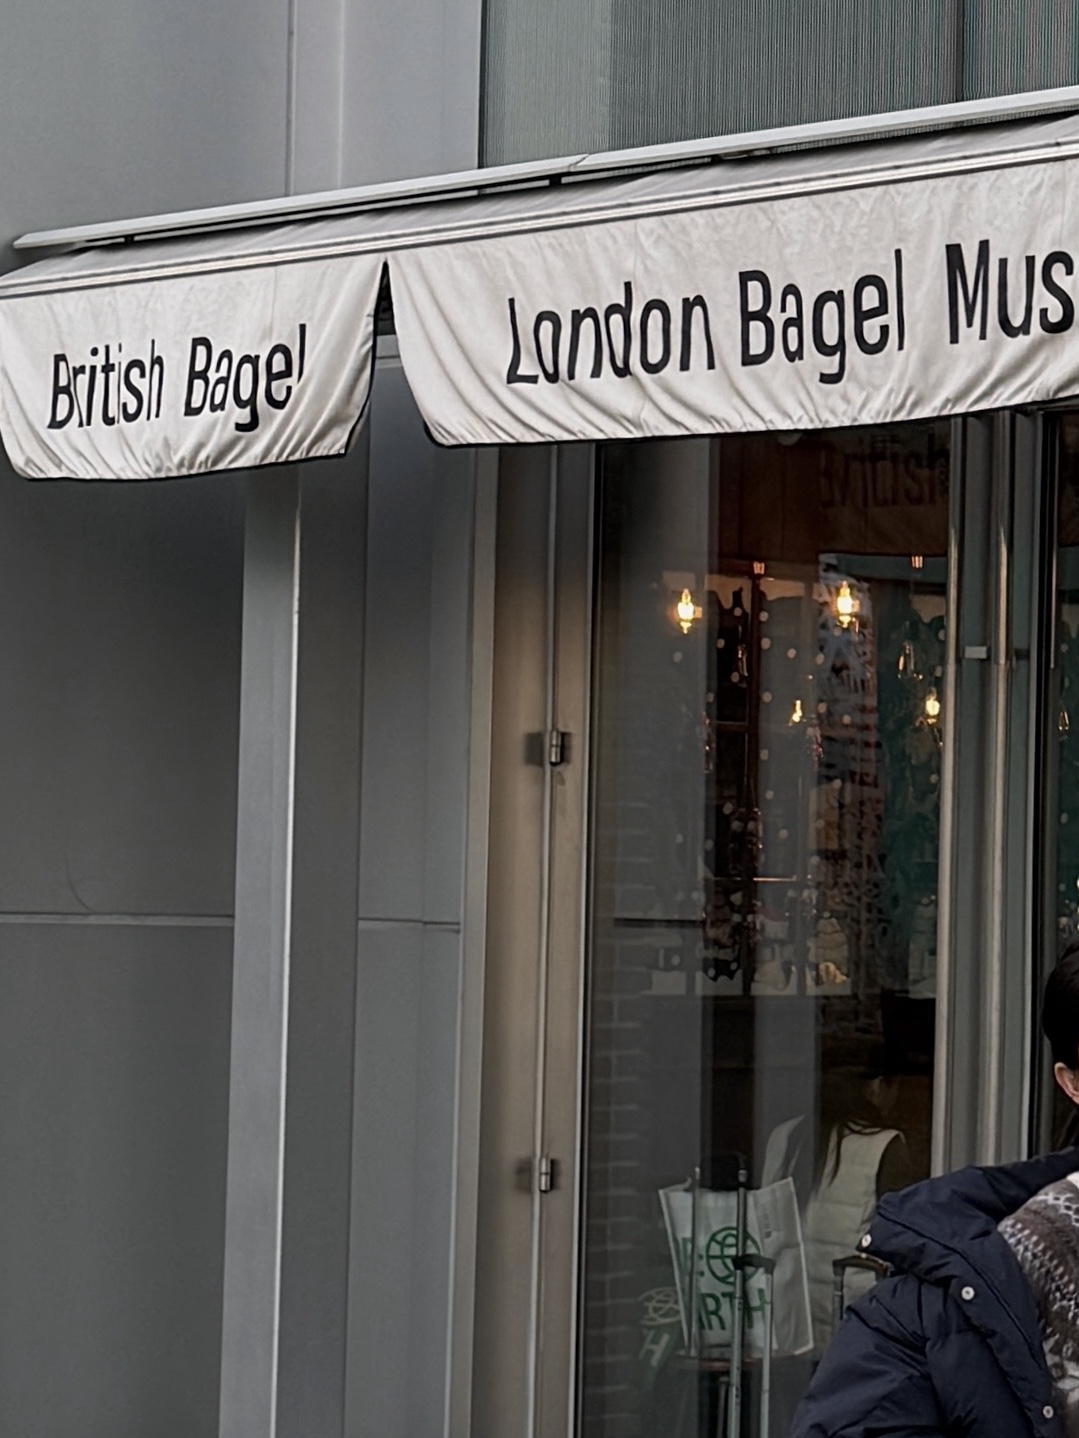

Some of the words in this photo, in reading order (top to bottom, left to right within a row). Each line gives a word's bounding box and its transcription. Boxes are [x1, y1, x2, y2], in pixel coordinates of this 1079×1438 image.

[47, 338, 164, 430] British
[183, 323, 307, 433] Bagel
[506, 280, 716, 385] London
[738, 248, 905, 385] Bagel
